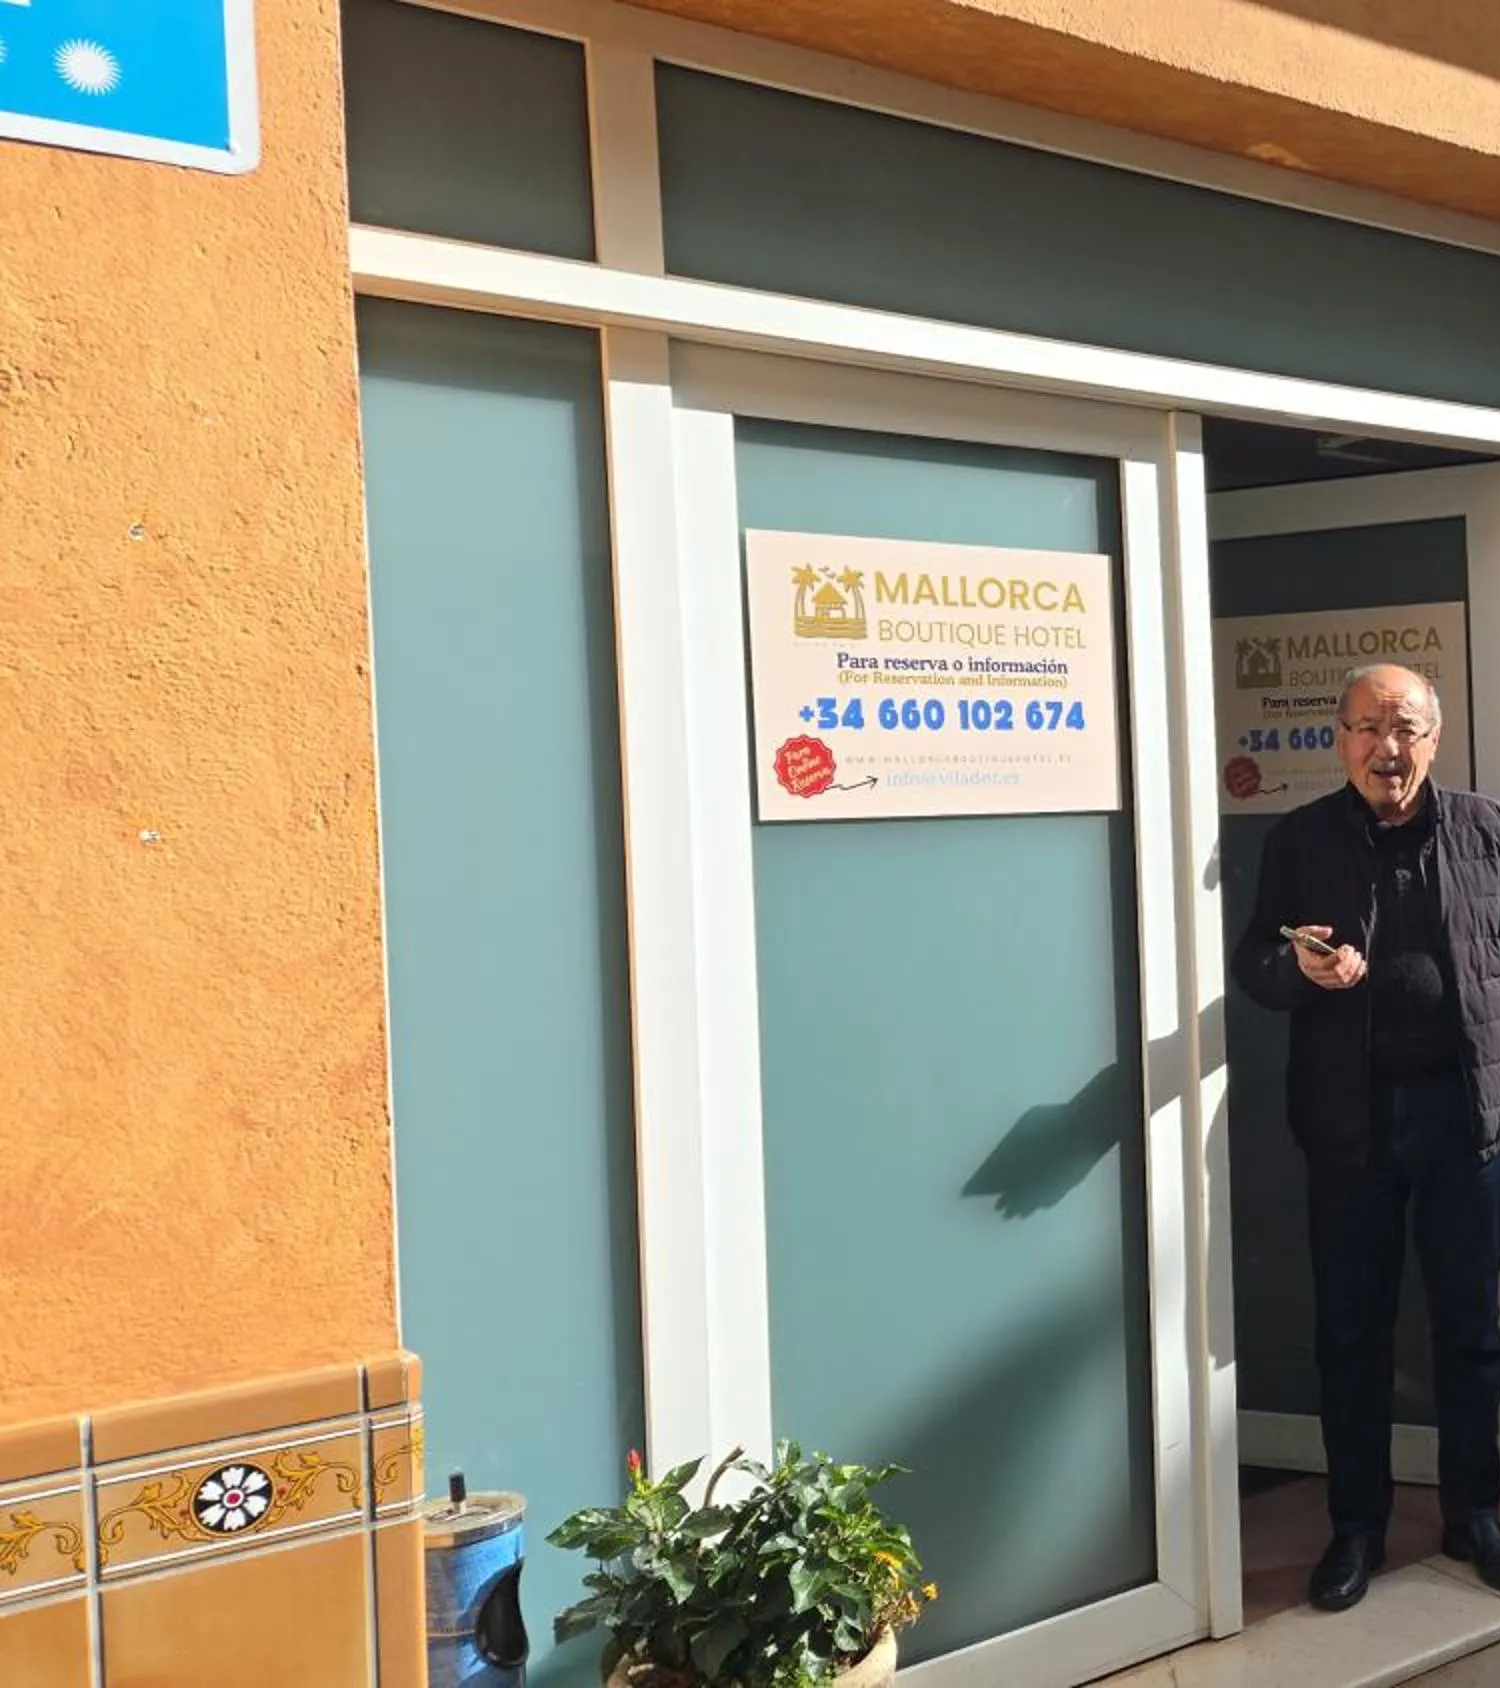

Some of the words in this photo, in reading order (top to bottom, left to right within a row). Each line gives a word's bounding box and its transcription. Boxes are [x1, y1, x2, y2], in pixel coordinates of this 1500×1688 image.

[874, 570, 1087, 613] MALLORCA
[878, 619, 1006, 648] BOUTIQUE
[1014, 625, 1087, 649] HOTEL
[1286, 625, 1443, 660] MALLORCA
[837, 652, 879, 669] Para
[884, 656, 949, 672] reserva
[953, 660, 963, 672] o
[968, 656, 1068, 675] información
[839, 671, 868, 685] (For
[872, 672, 955, 686] Reservation
[959, 675, 983, 687] and
[986, 675, 1068, 689] Information)
[799, 696, 865, 731] +34
[878, 697, 945, 731] 660
[958, 698, 1014, 731] 102
[1025, 699, 1086, 731] 674
[1262, 696, 1289, 709] Para
[1293, 695, 1337, 708] reserva
[1238, 727, 1281, 752] +34
[1289, 725, 1335, 750] 660
